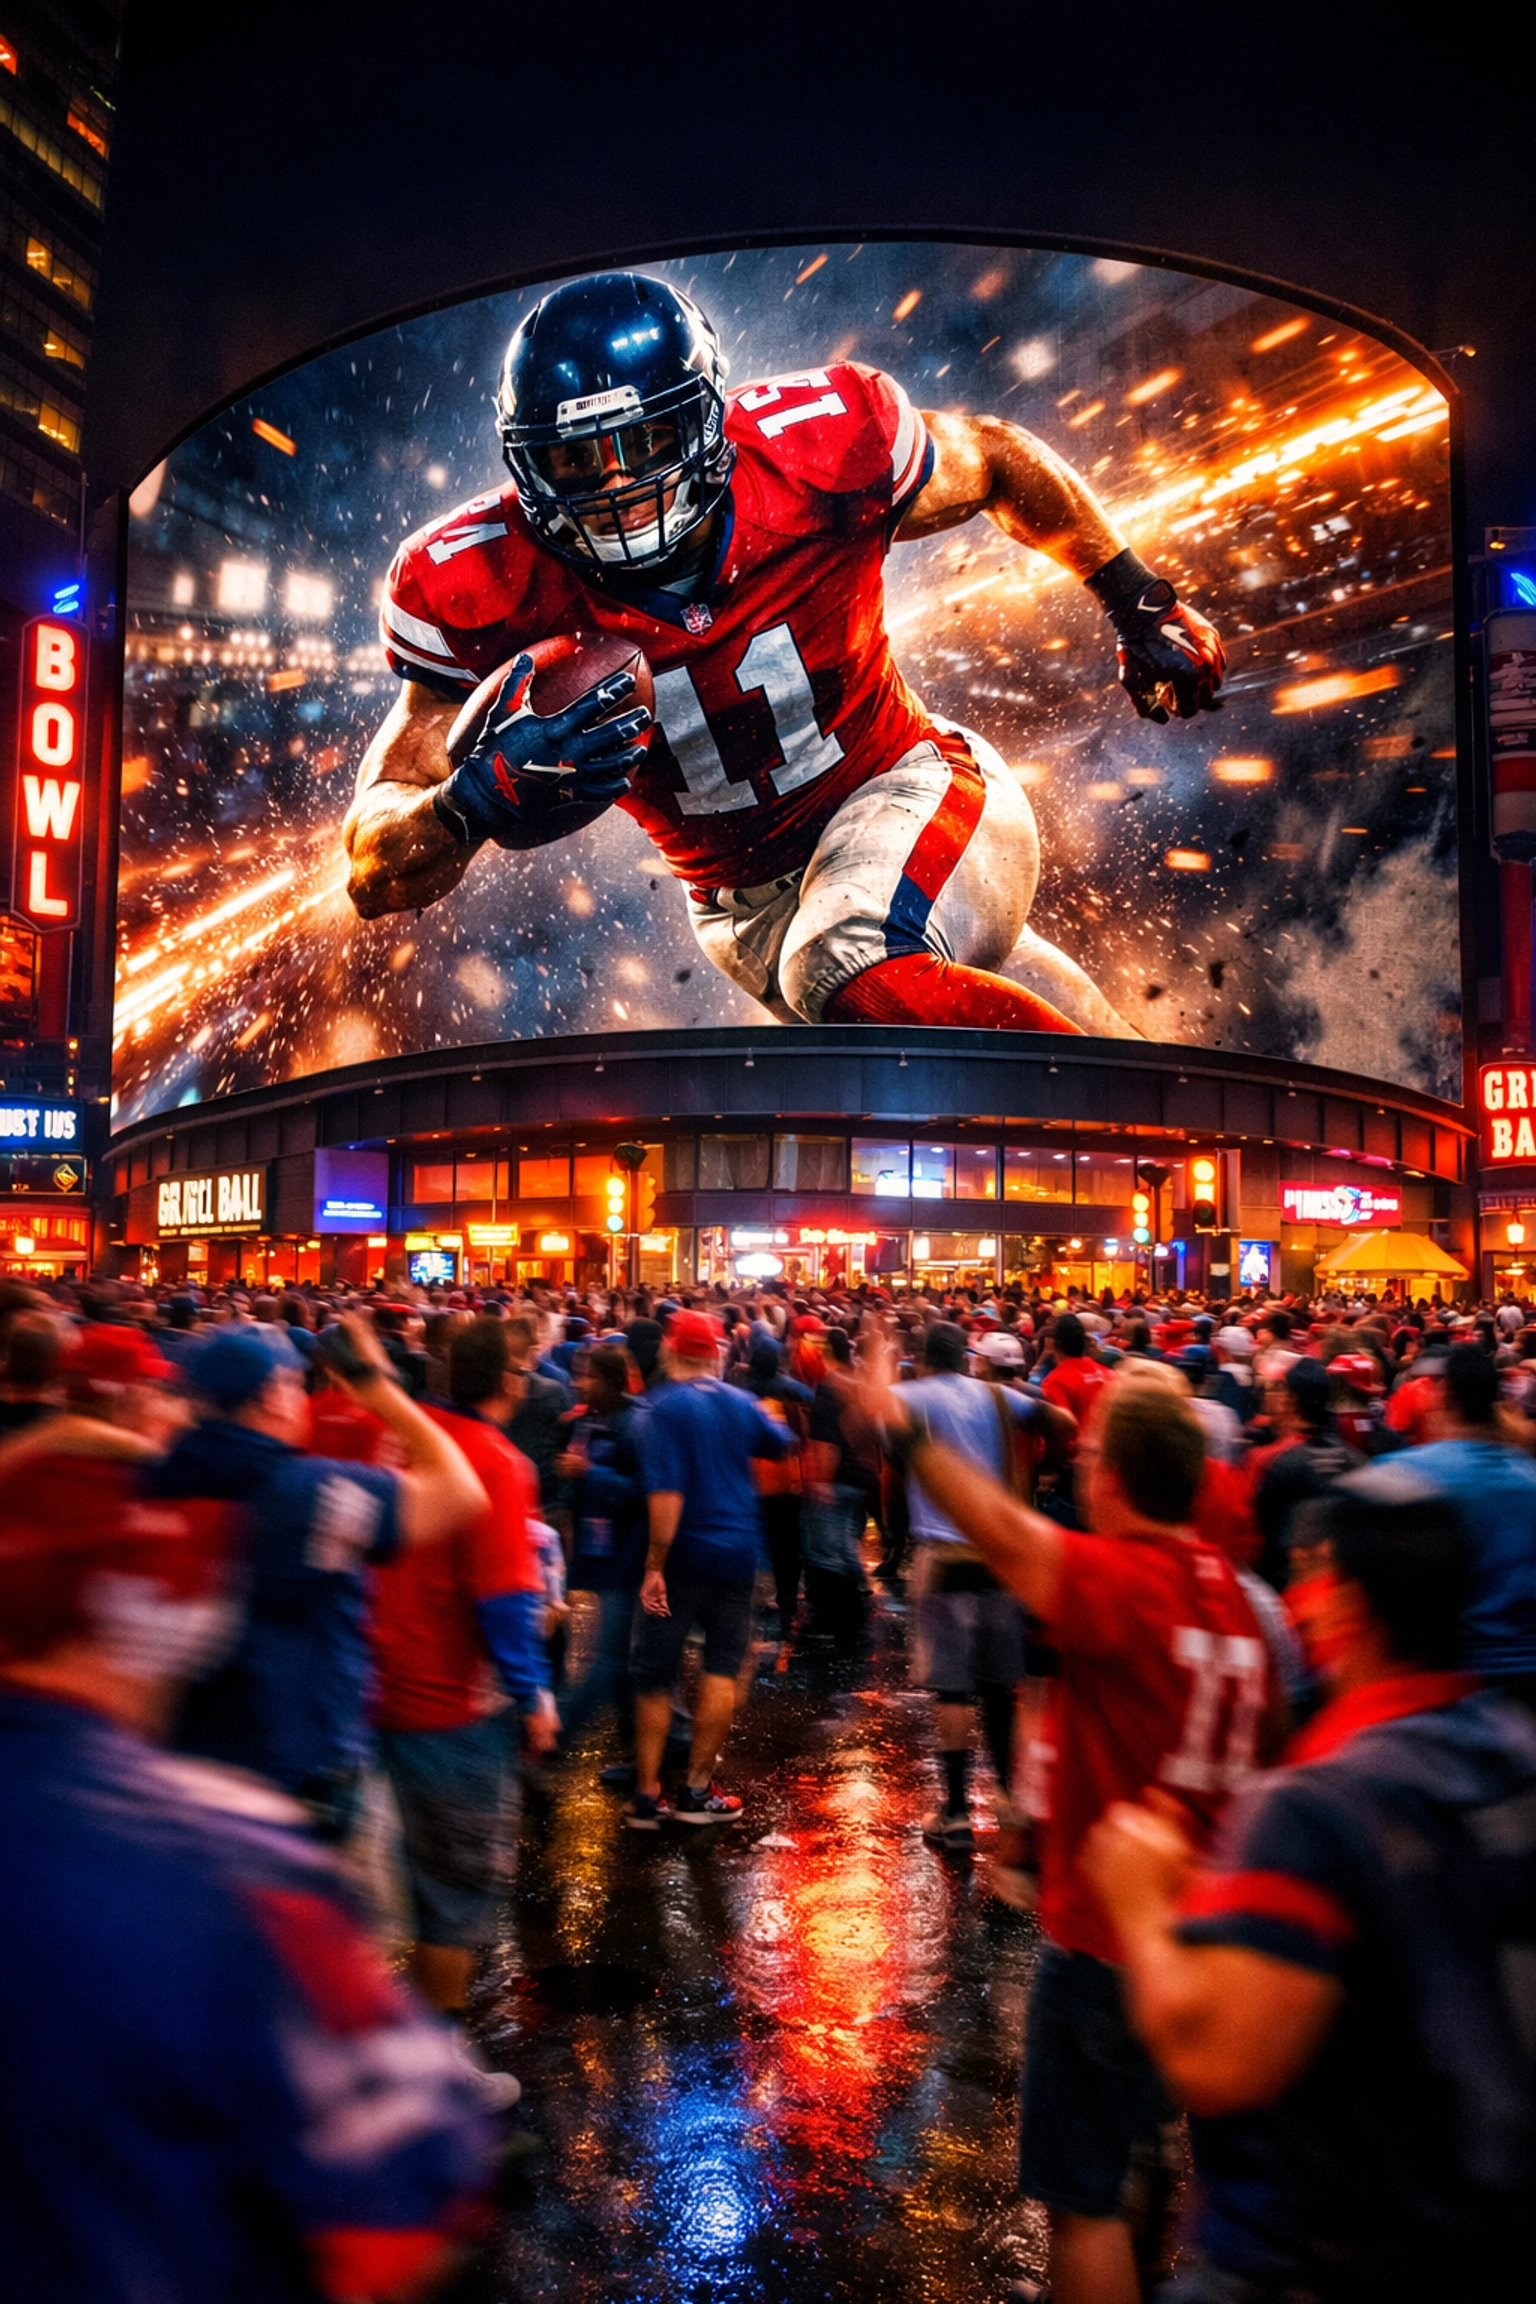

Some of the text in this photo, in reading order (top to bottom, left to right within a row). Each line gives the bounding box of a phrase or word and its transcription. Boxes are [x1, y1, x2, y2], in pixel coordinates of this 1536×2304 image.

[23, 624, 80, 917] BOWL
[653, 622, 846, 816] 11
[218, 1173, 262, 1222] BALL
